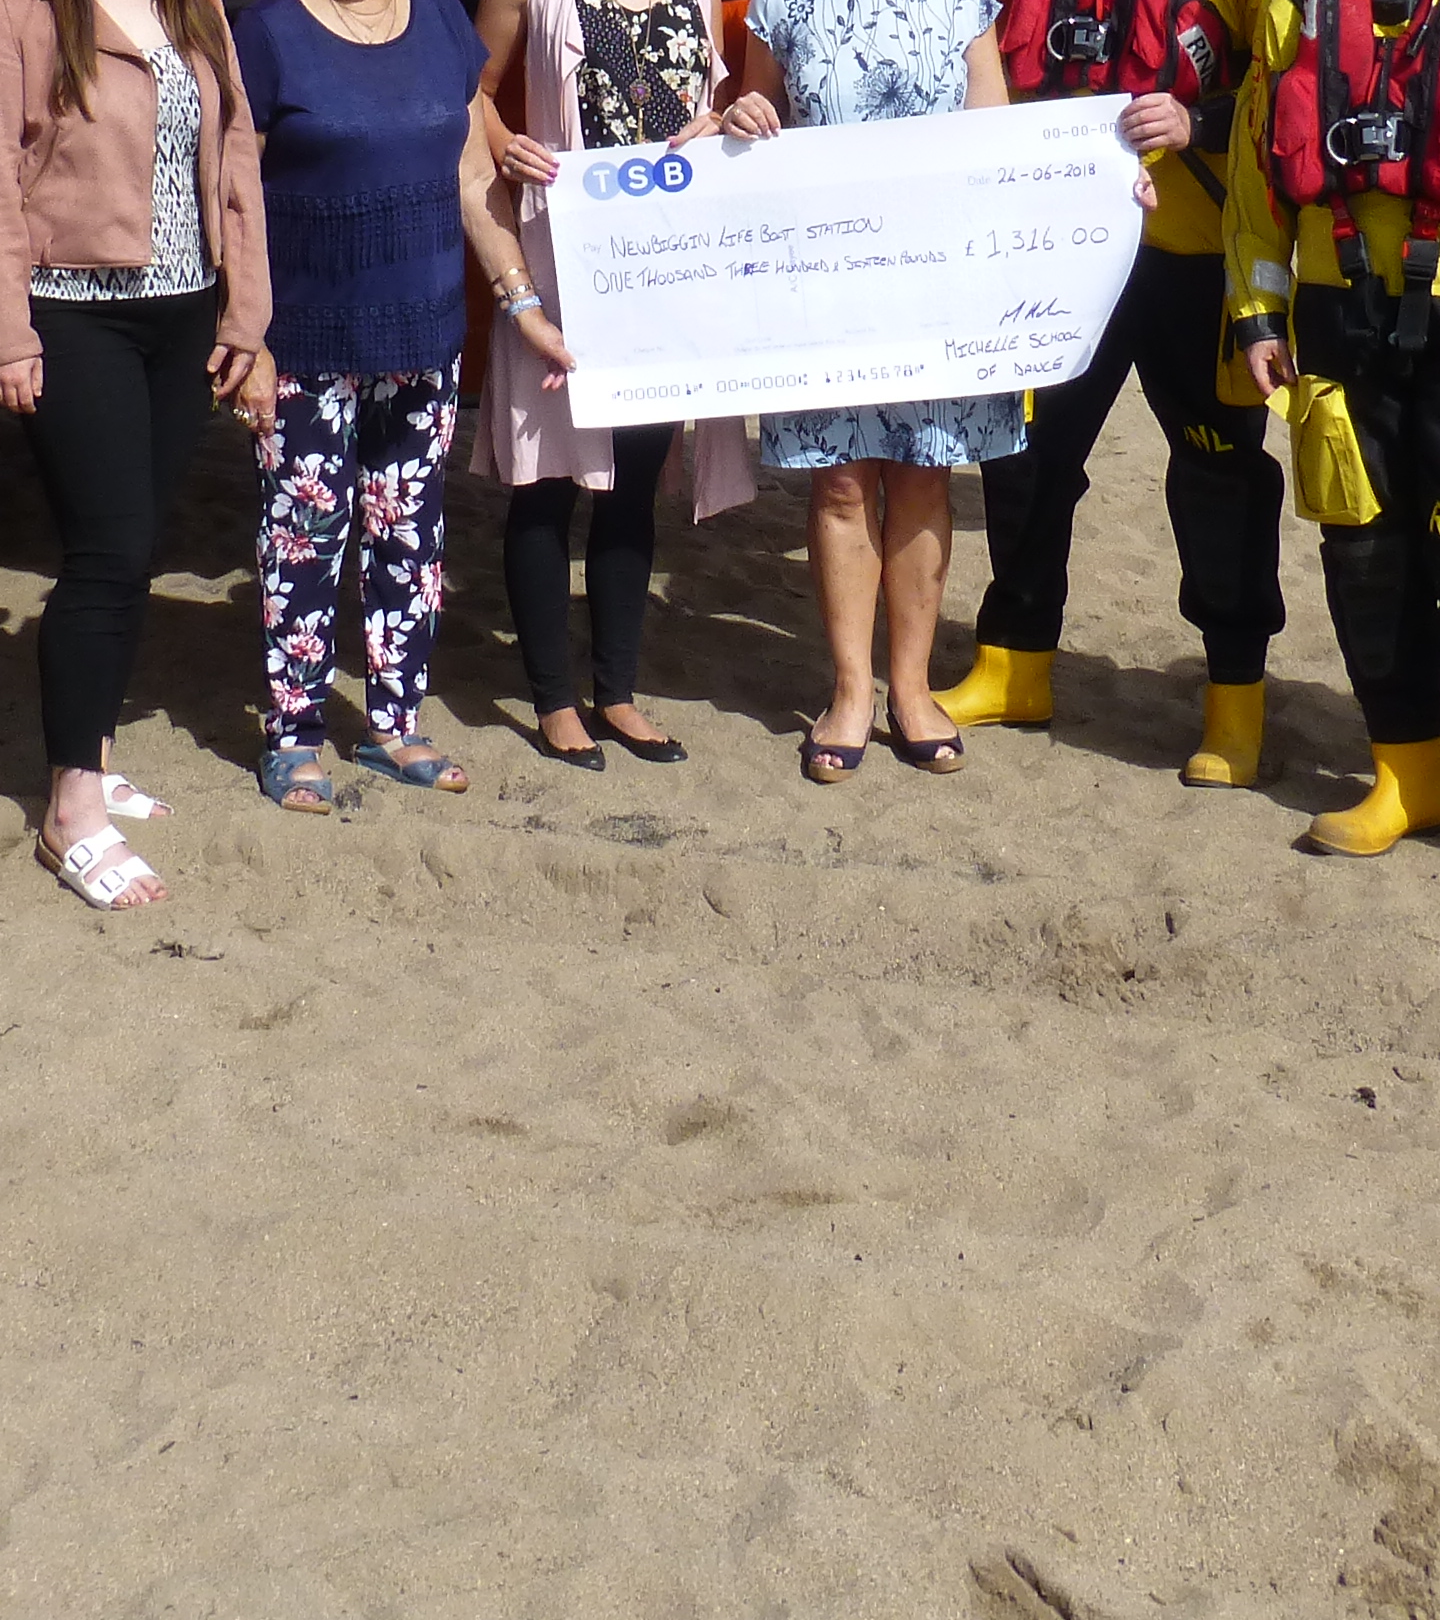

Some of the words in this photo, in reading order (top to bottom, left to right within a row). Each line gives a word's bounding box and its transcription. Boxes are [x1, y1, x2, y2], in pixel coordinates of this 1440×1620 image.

[1042, 121, 1117, 140] 00-00-00
[590, 160, 687, 195] TSB
[610, 232, 710, 259] NEWBIGGIN
[718, 225, 754, 248] LIFE
[806, 216, 884, 239] STATION
[593, 269, 634, 294] ONE
[725, 260, 770, 281] THREE
[944, 335, 1020, 362] MICHELLE
[1028, 326, 1083, 350] SCHOOL
[976, 364, 997, 381] OF
[1013, 355, 1065, 377] DANCE
